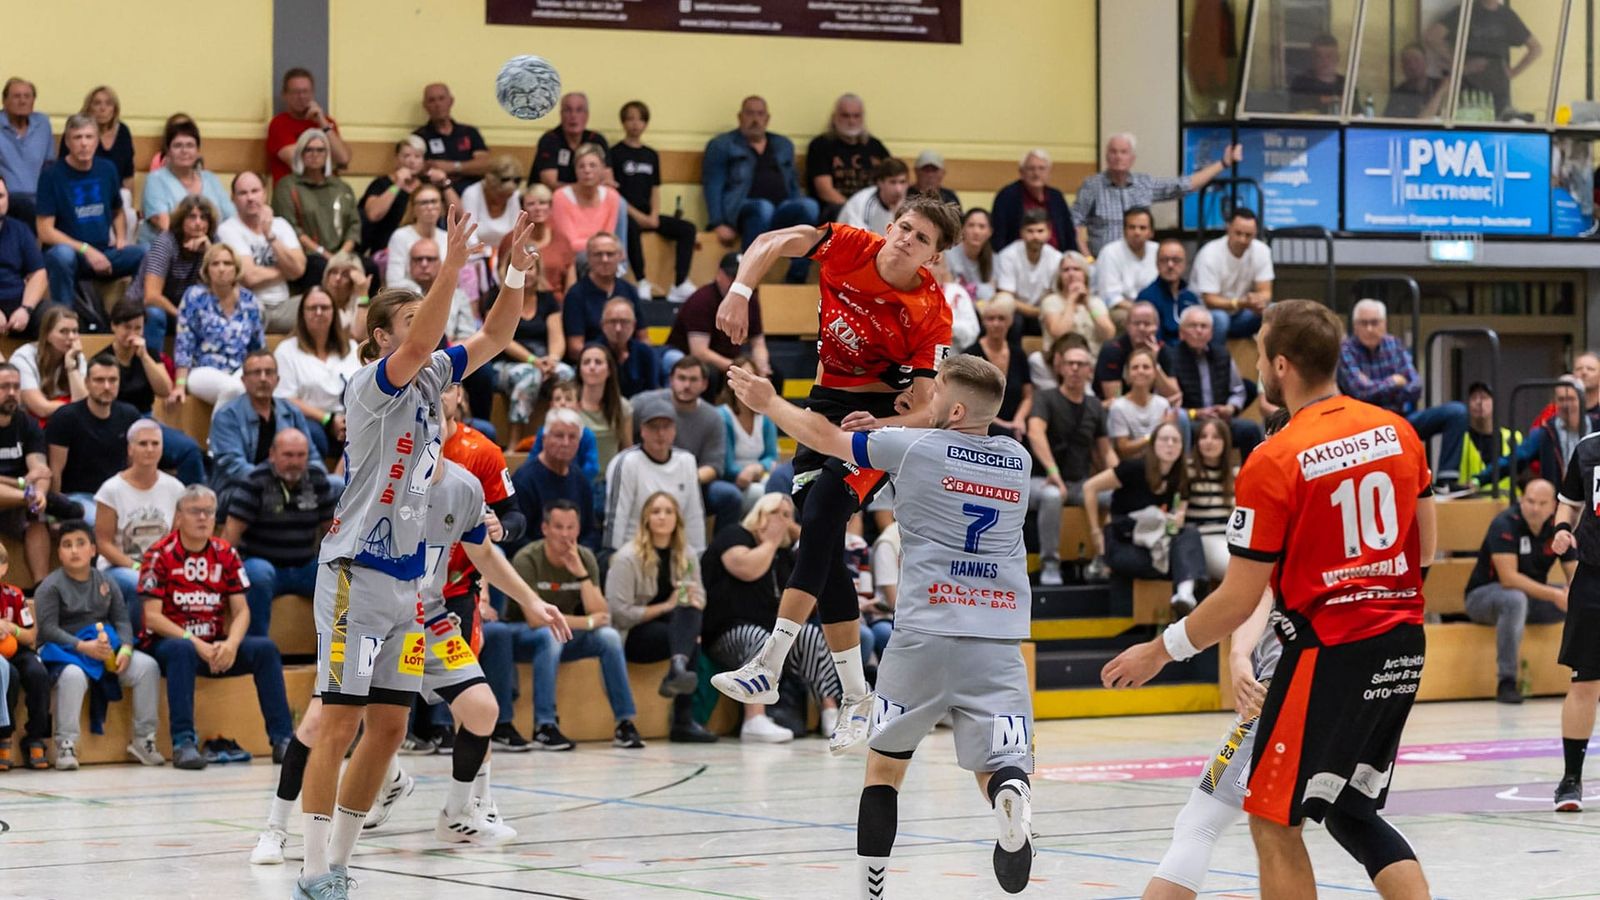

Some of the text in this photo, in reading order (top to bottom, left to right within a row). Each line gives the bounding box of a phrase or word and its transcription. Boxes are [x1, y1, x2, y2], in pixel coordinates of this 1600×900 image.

[1409, 138, 1488, 177] PWA
[1405, 184, 1492, 201] ELECTRONIC
[950, 447, 1022, 470] BAUSCHER
[1302, 437, 1370, 469] Aktobis
[1374, 427, 1397, 446] AG
[955, 481, 1020, 502] BAUHAUS
[1330, 471, 1399, 558] 10
[962, 502, 1000, 554] 7
[184, 556, 209, 582] 68
[950, 560, 998, 579] HANNES
[173, 590, 221, 605] brother
[927, 583, 1016, 602] JOCKERS
[928, 596, 977, 607] SAUNA
[990, 600, 1017, 610] BAU
[1220, 744, 1235, 760] 33
